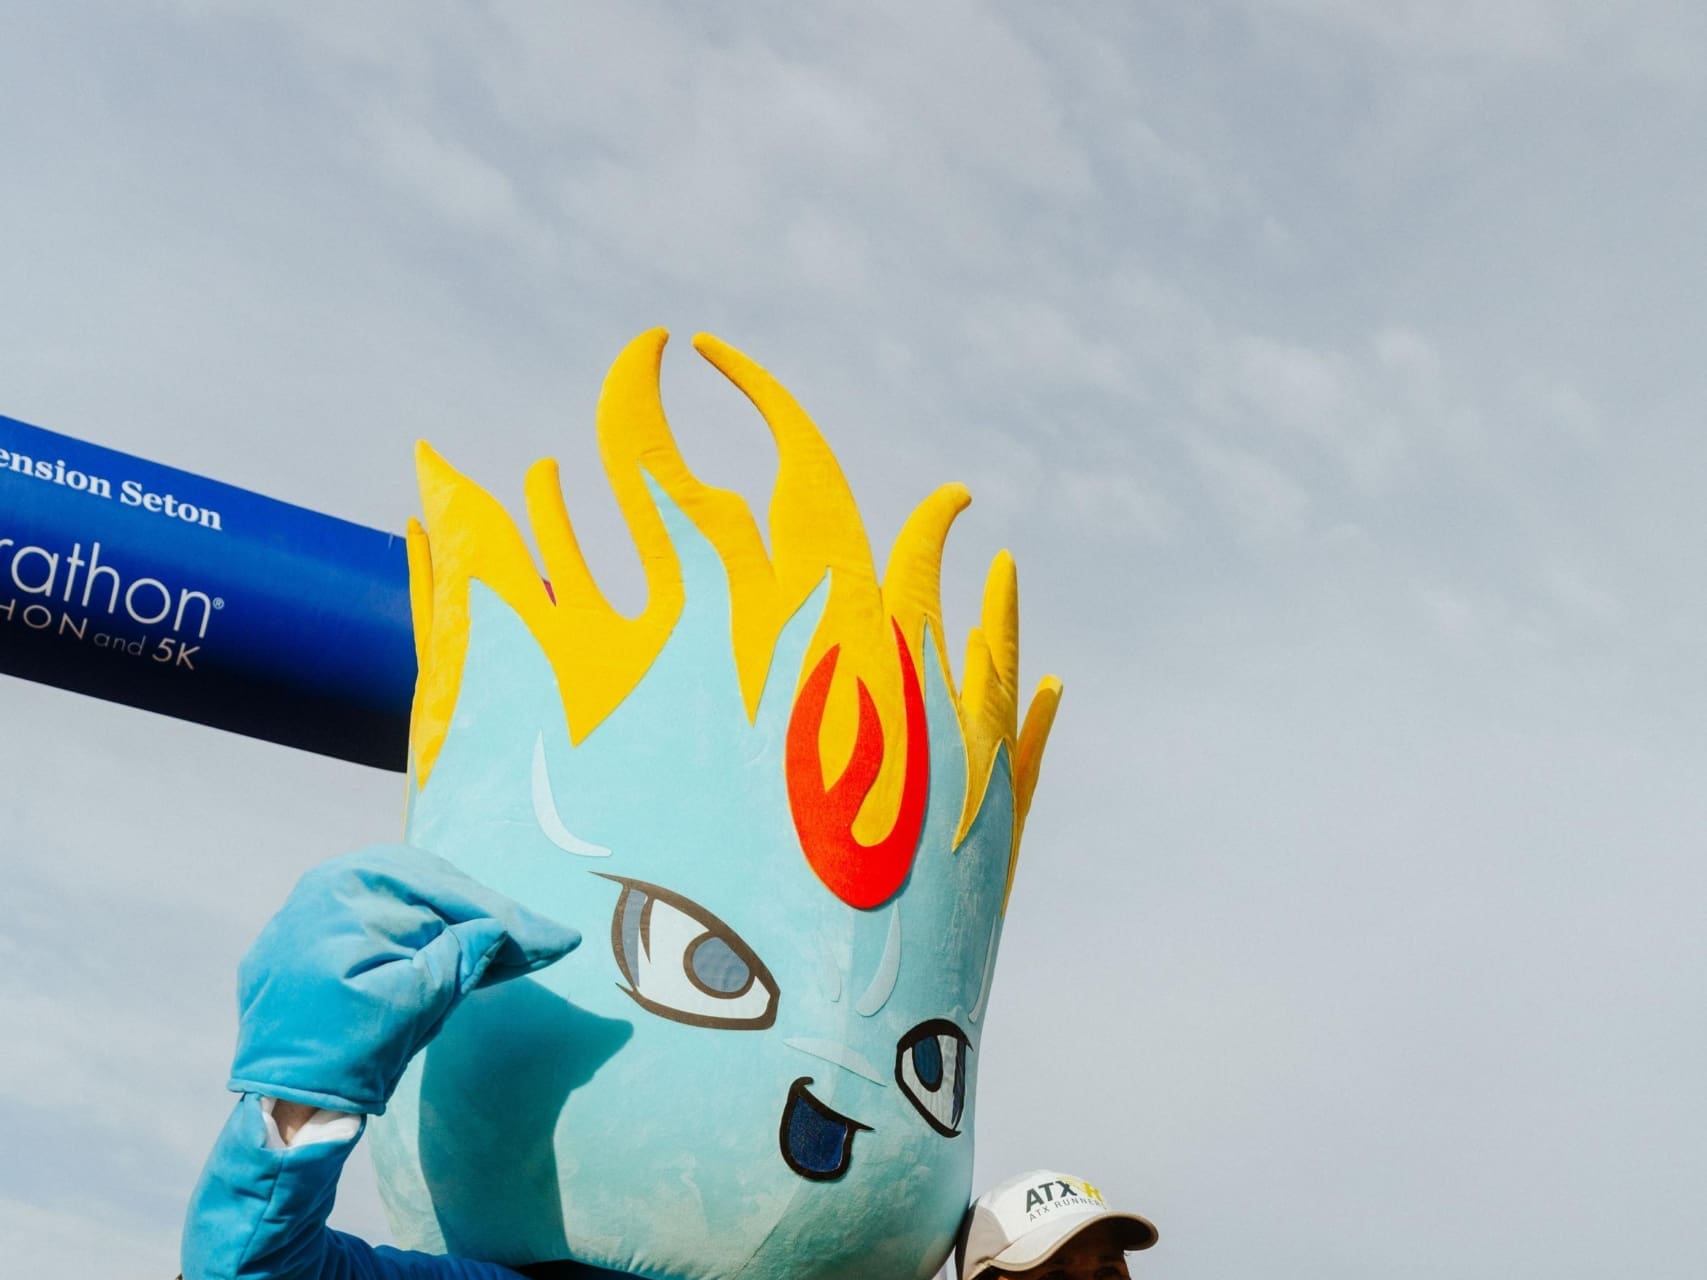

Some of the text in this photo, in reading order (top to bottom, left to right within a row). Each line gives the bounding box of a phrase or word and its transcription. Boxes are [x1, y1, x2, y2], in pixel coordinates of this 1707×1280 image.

[120, 480, 223, 530] Seton
[94, 630, 147, 656] and
[152, 637, 200, 670] 5K
[1026, 1180, 1078, 1214] ATX
[1029, 1205, 1050, 1222] ATX
